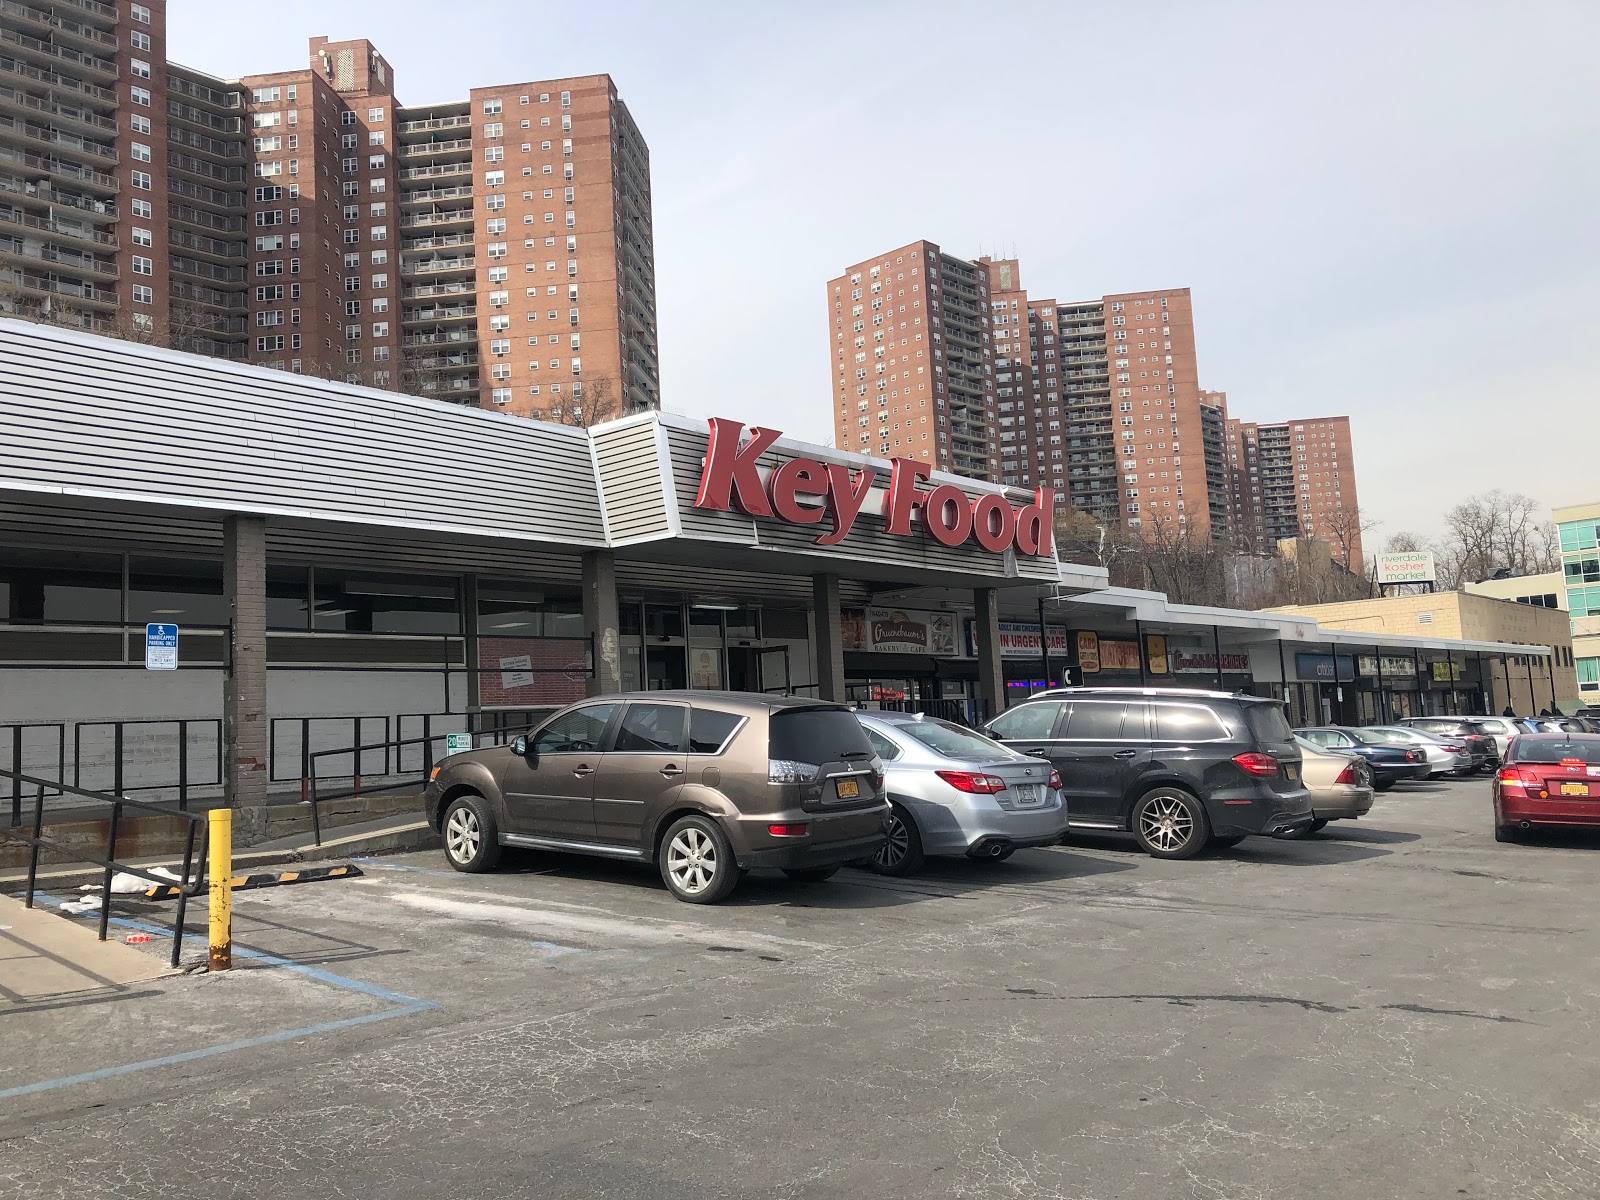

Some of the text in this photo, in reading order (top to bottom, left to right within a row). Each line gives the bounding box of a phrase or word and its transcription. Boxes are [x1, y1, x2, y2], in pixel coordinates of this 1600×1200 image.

[692, 416, 1056, 556] Key Food
[1381, 554, 1428, 563] riverdale
[1384, 563, 1426, 572] kosher
[1386, 571, 1426, 581] market
[1045, 636, 1067, 649] CARE
[1079, 636, 1097, 650] CARD
[448, 736, 457, 747] 20
